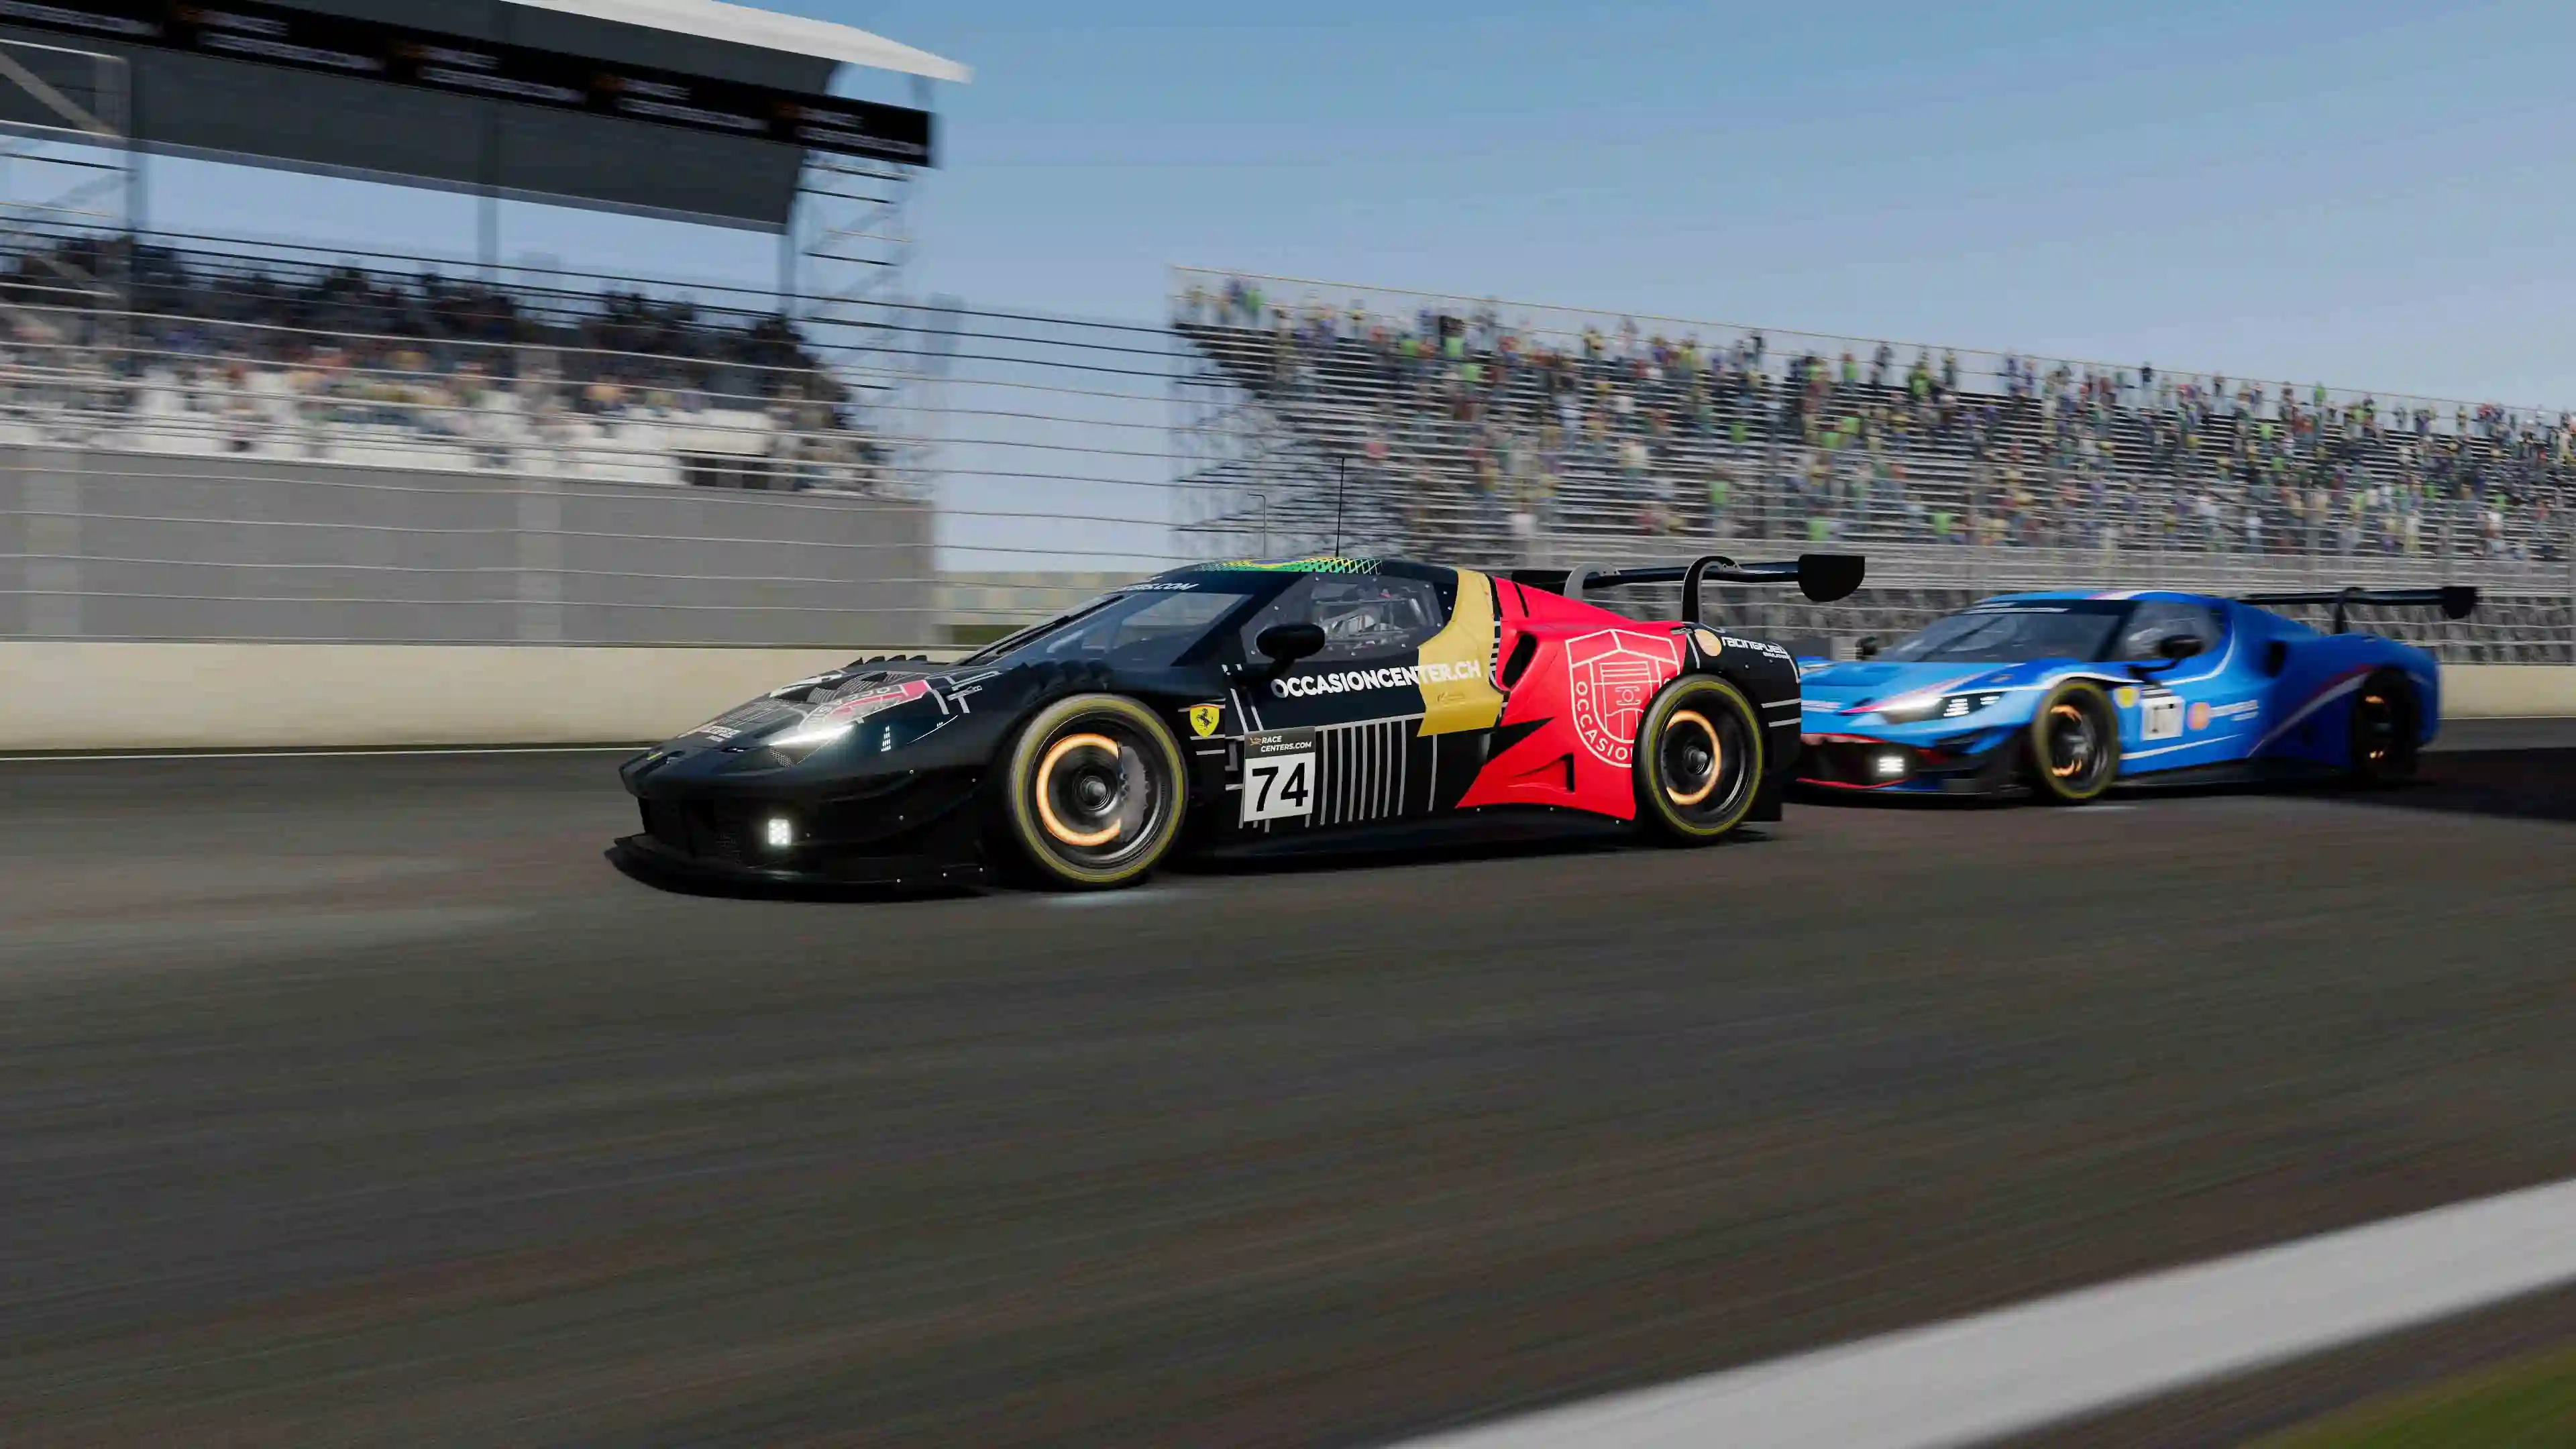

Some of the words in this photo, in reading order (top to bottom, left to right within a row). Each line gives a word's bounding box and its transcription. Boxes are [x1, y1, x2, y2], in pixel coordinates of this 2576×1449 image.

[1271, 659, 1481, 698] OCCASIONCENTER.CH
[1260, 741, 1312, 753] CENTERS.COM
[1262, 736, 1282, 744] RACE
[1252, 762, 1308, 812] 74
